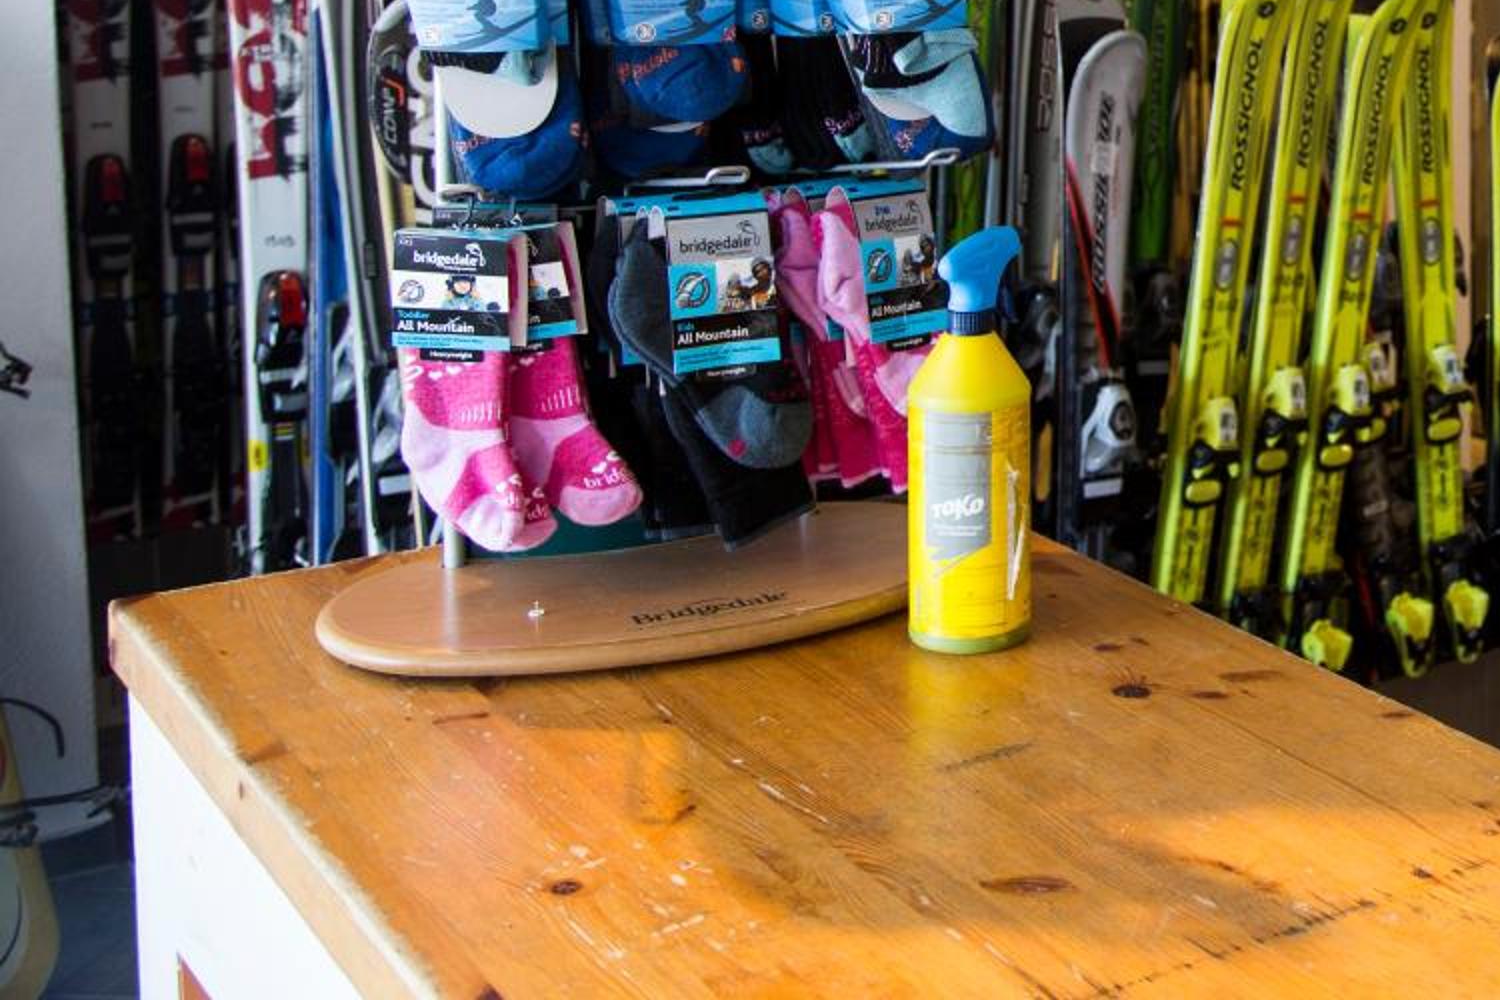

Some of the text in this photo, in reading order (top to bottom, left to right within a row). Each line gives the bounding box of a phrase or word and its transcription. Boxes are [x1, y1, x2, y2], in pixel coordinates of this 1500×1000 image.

[1297, 18, 1329, 169] ROSSIGNOL
[1417, 47, 1435, 174] ROSSIGNOL
[1231, 37, 1264, 191] ROSSIGNOL
[1362, 54, 1393, 185] ROSSIGNOL
[412, 249, 478, 267] bridgedale
[679, 232, 753, 255] bridgedale
[397, 319, 475, 334] All Mountain
[677, 326, 749, 346] All Mountain
[630, 591, 788, 626] Bridgedale
